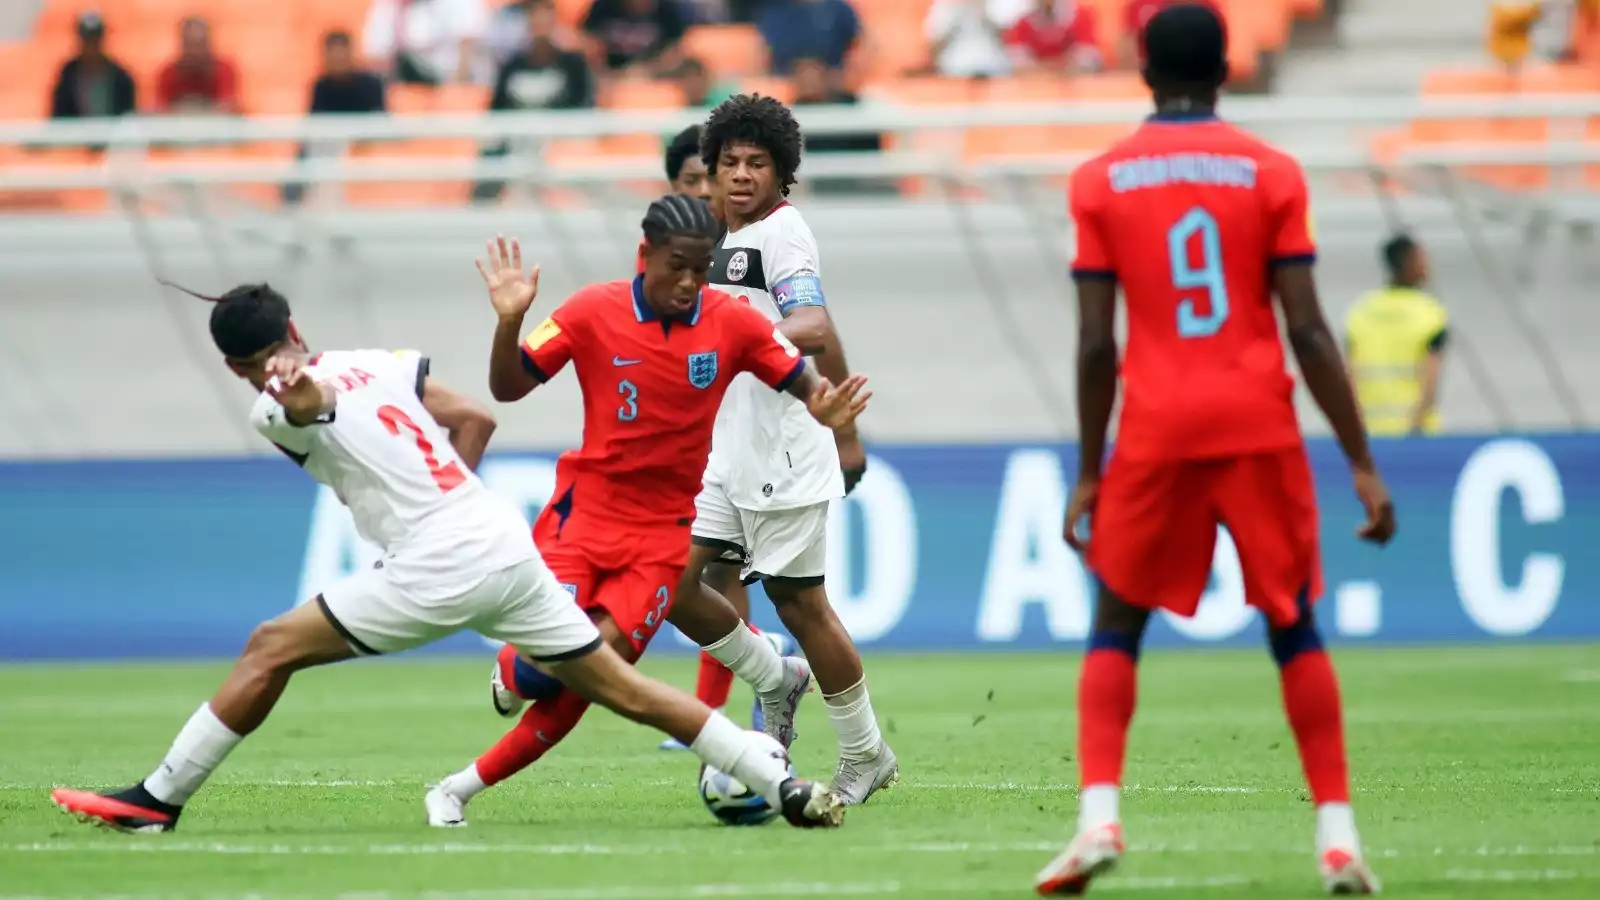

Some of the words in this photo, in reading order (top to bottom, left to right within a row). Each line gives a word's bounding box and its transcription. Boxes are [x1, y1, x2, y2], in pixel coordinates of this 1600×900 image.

[1168, 205, 1230, 338] 9
[616, 379, 638, 422] 3
[377, 404, 467, 494] 2
[644, 585, 669, 627] 3
